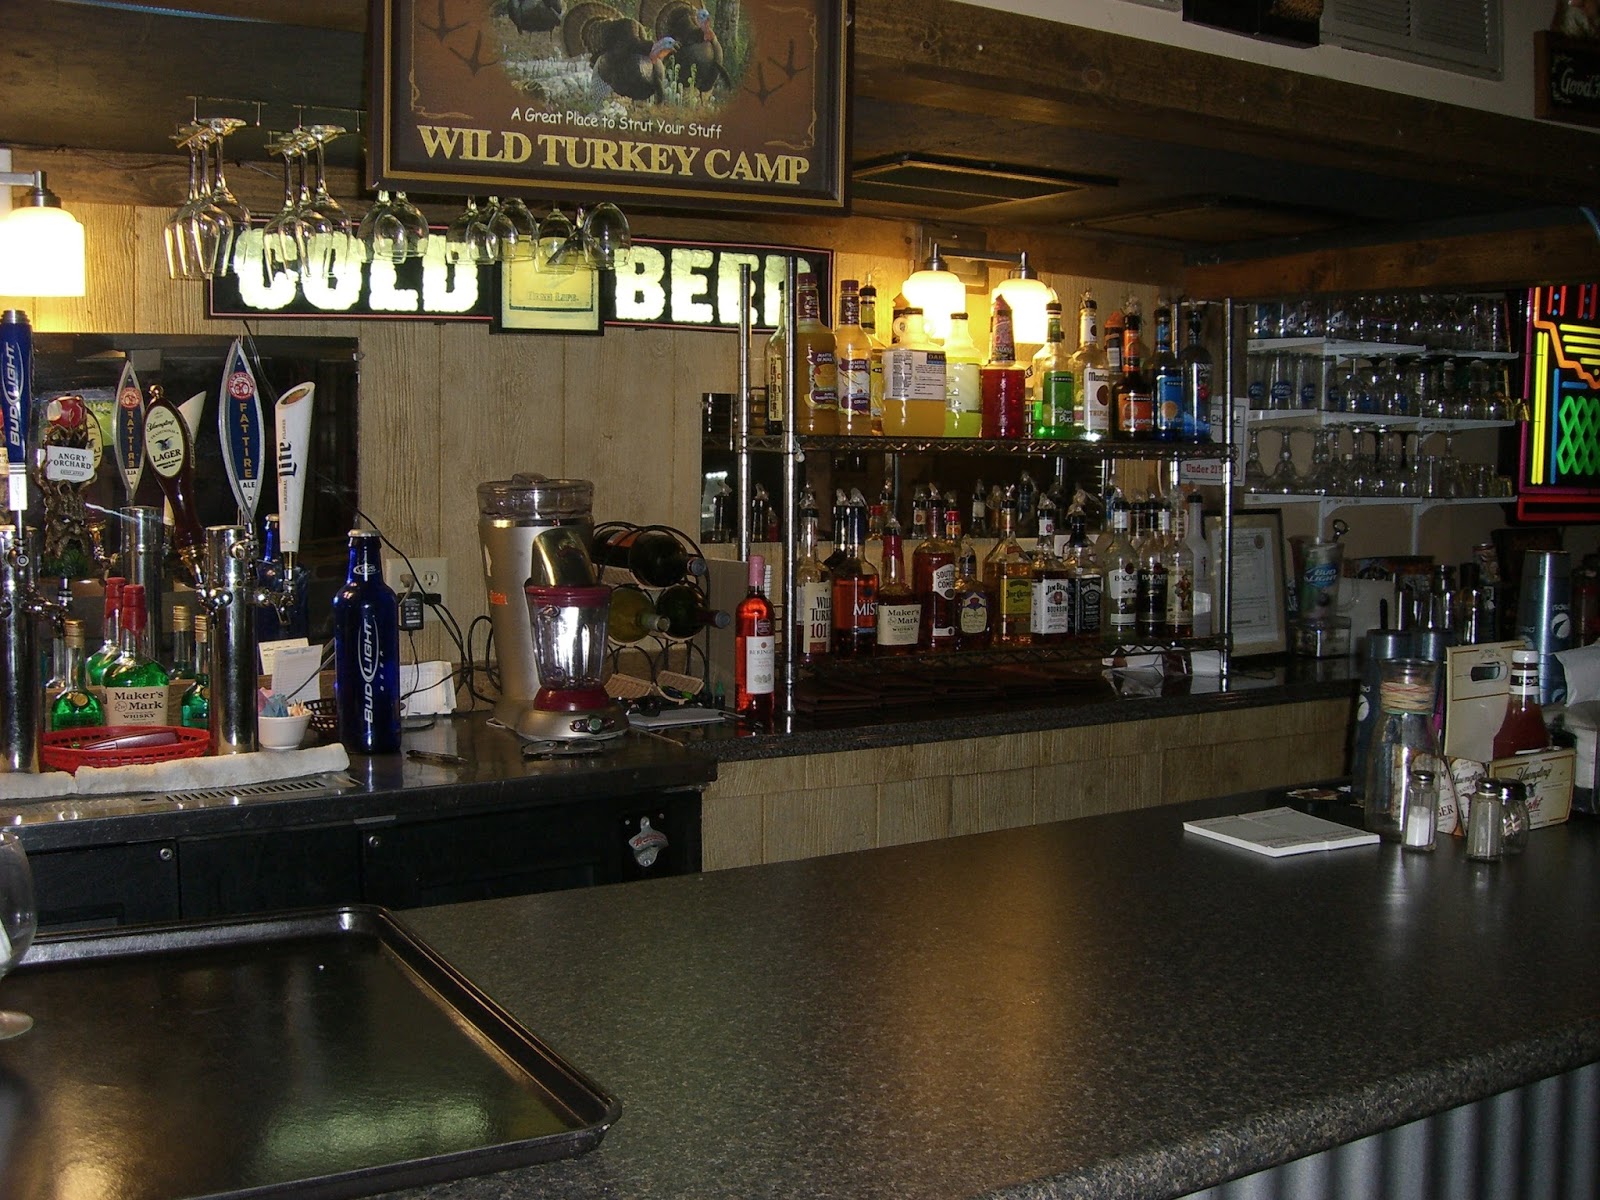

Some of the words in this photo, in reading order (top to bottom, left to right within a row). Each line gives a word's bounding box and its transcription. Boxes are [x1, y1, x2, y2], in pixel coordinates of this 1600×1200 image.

[511, 107, 521, 120] A
[524, 108, 562, 124] Great
[565, 111, 598, 127] Place
[602, 115, 615, 129] to
[619, 116, 653, 131] Strut
[656, 120, 685, 135] Your
[688, 123, 722, 139] Stuff
[416, 125, 532, 164] WILD
[537, 134, 701, 177] TURKEY
[704, 149, 810, 185] CAMP
[233, 228, 479, 313] COLD
[5, 341, 19, 398] LIGHT
[9, 405, 20, 447] BUD
[240, 402, 250, 431] FAT
[53, 459, 92, 470] ORCHARD
[58, 453, 87, 462] ANGRY
[152, 448, 182, 463] LAGER
[242, 436, 253, 478] TIRE
[278, 441, 298, 479] Lite
[1186, 463, 1208, 474] Under
[1314, 568, 1336, 576] BUD
[853, 602, 879, 616] MIST
[810, 623, 827, 638] 101
[897, 617, 919, 625] Mark
[363, 618, 373, 677] LIGHT
[114, 691, 164, 700] Maker's
[129, 701, 163, 710] Mark
[364, 682, 373, 724] BUD
